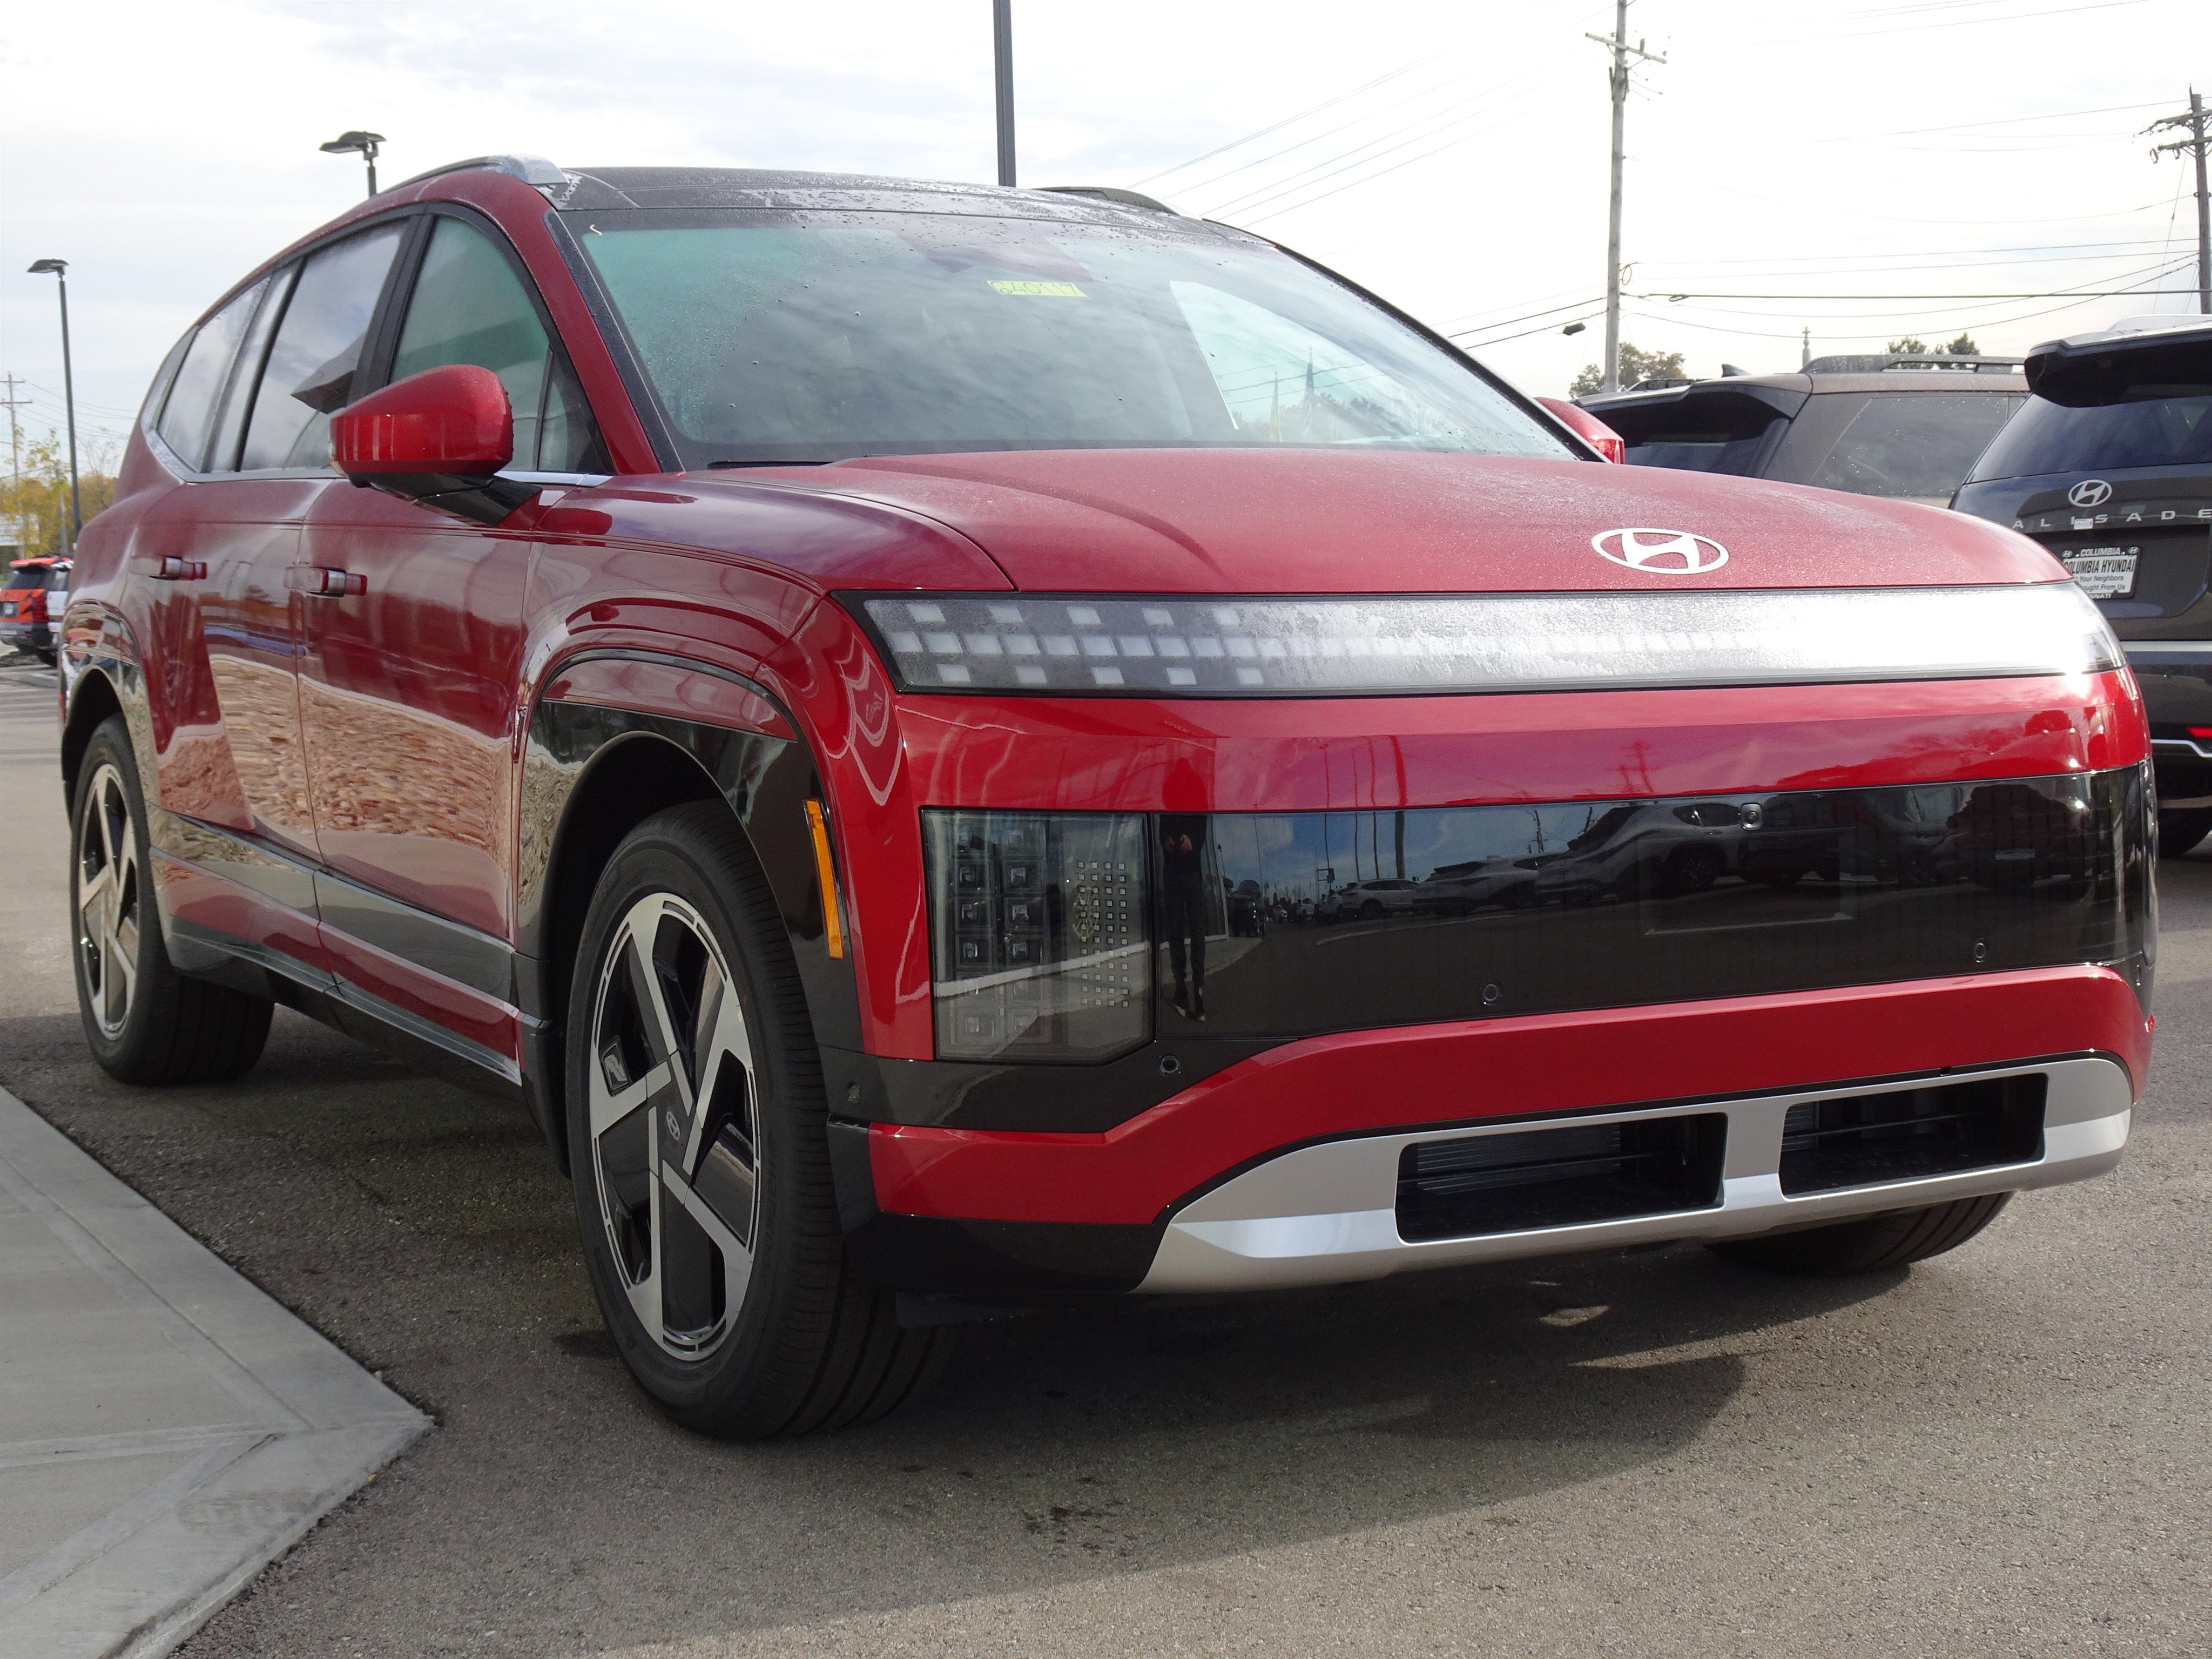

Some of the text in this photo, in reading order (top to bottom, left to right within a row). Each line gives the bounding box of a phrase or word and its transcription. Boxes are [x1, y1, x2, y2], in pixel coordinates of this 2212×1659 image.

[2012, 508, 2212, 529] ALISADE
[2080, 547, 2120, 557] COLUMBIA
[2101, 559, 2135, 572] HYUNDAI
